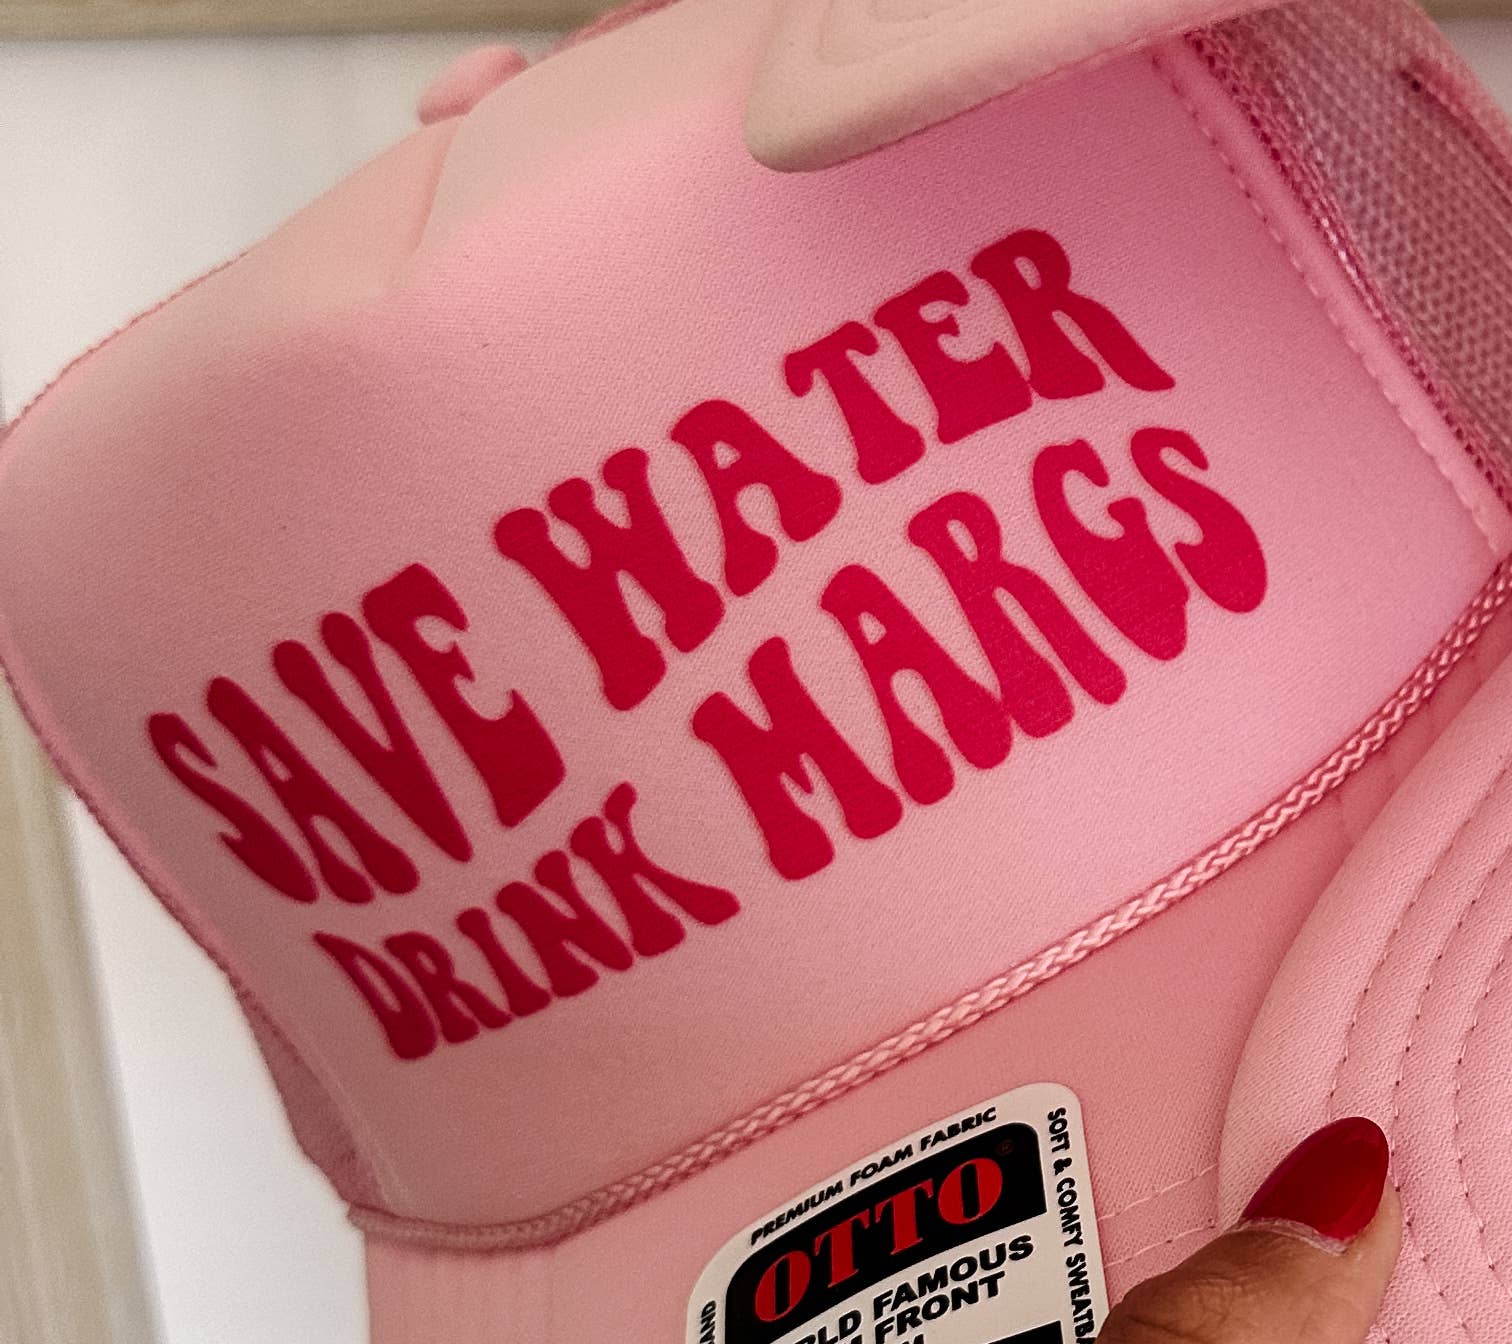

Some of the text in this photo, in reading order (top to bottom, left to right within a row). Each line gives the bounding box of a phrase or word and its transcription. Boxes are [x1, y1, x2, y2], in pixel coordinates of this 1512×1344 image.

[147, 228, 1176, 904] SAVE WATER
[312, 426, 1269, 1061] DRINK MARGS
[750, 1106, 997, 1245] PREMIUM FOAM FABRIC
[1047, 1107, 1068, 1153] SOFT
[1053, 1156, 1073, 1177] &
[754, 1157, 1004, 1323] OTTO
[1055, 1177, 1083, 1247] COMFY
[872, 1234, 1035, 1316] FAMOUS
